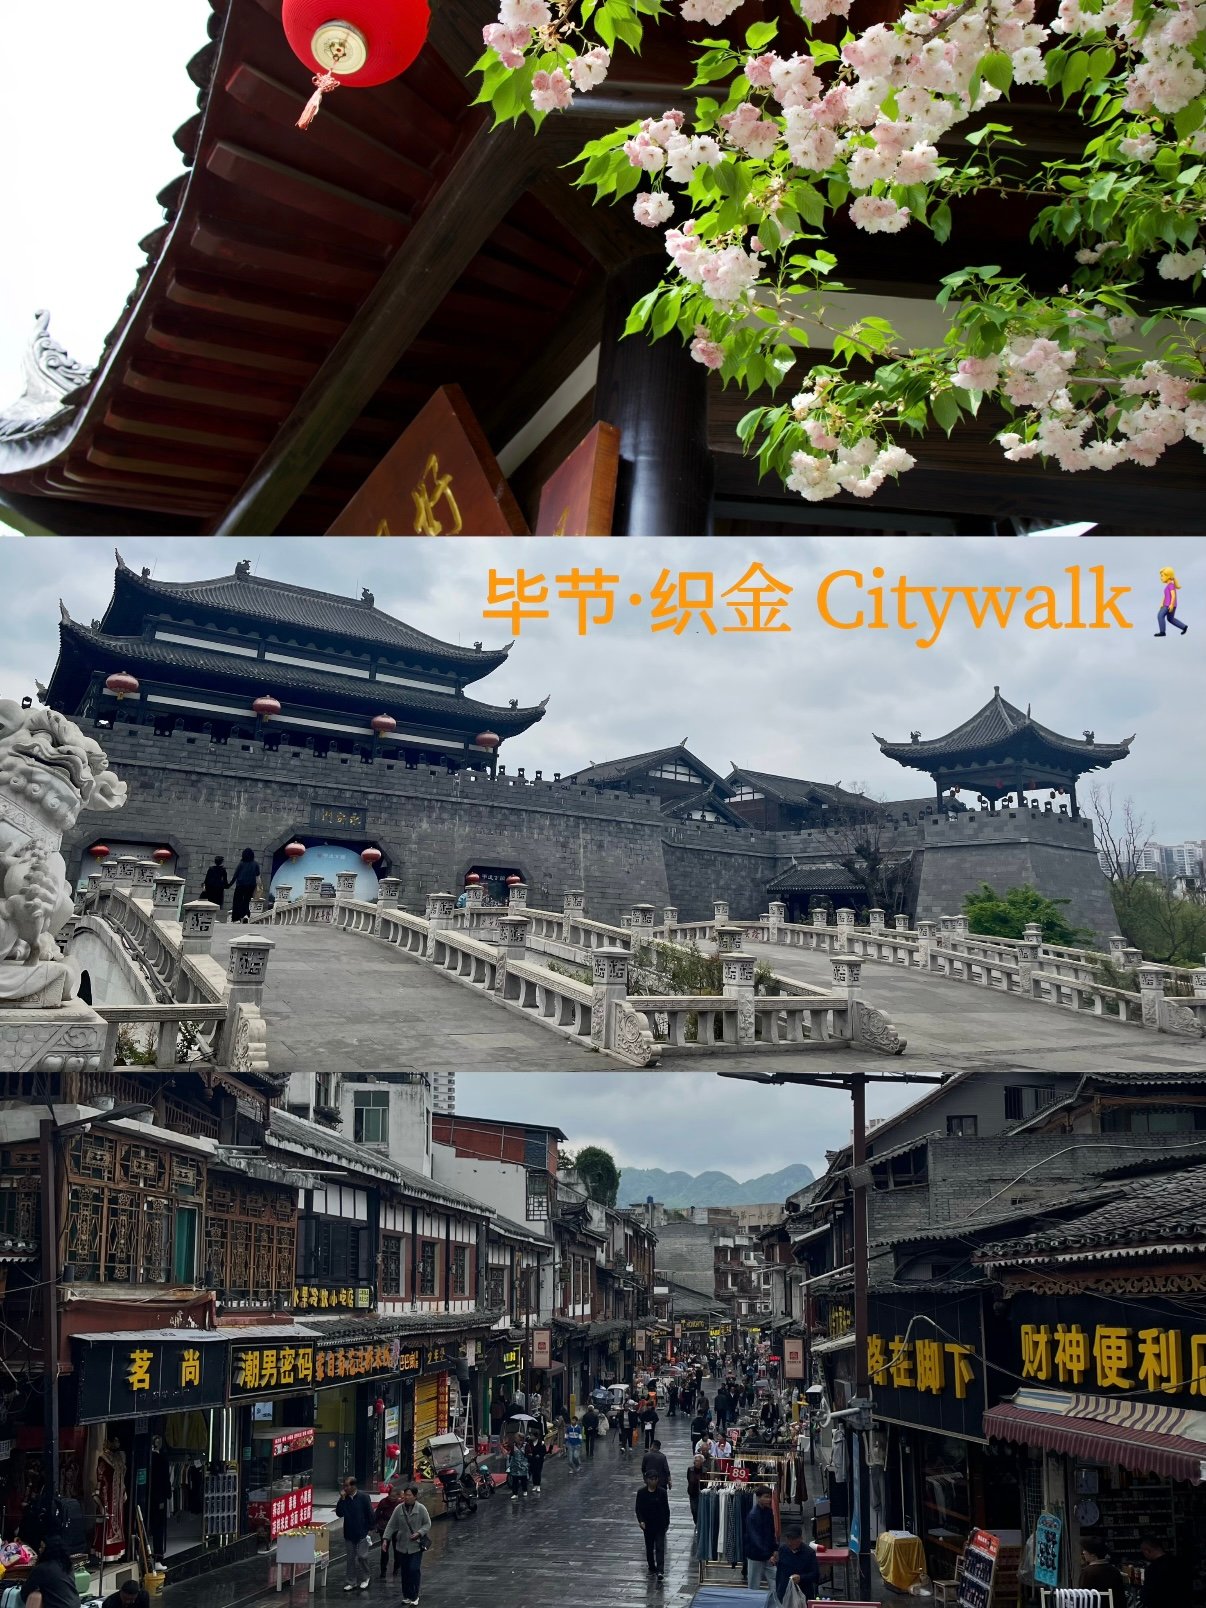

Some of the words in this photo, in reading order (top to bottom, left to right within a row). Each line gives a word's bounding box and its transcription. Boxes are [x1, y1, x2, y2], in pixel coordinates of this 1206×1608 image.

[238, 1346, 313, 1389] 潮男密码
[867, 1333, 976, 1399] 路在脚下
[732, 1468, 746, 1479] 89
